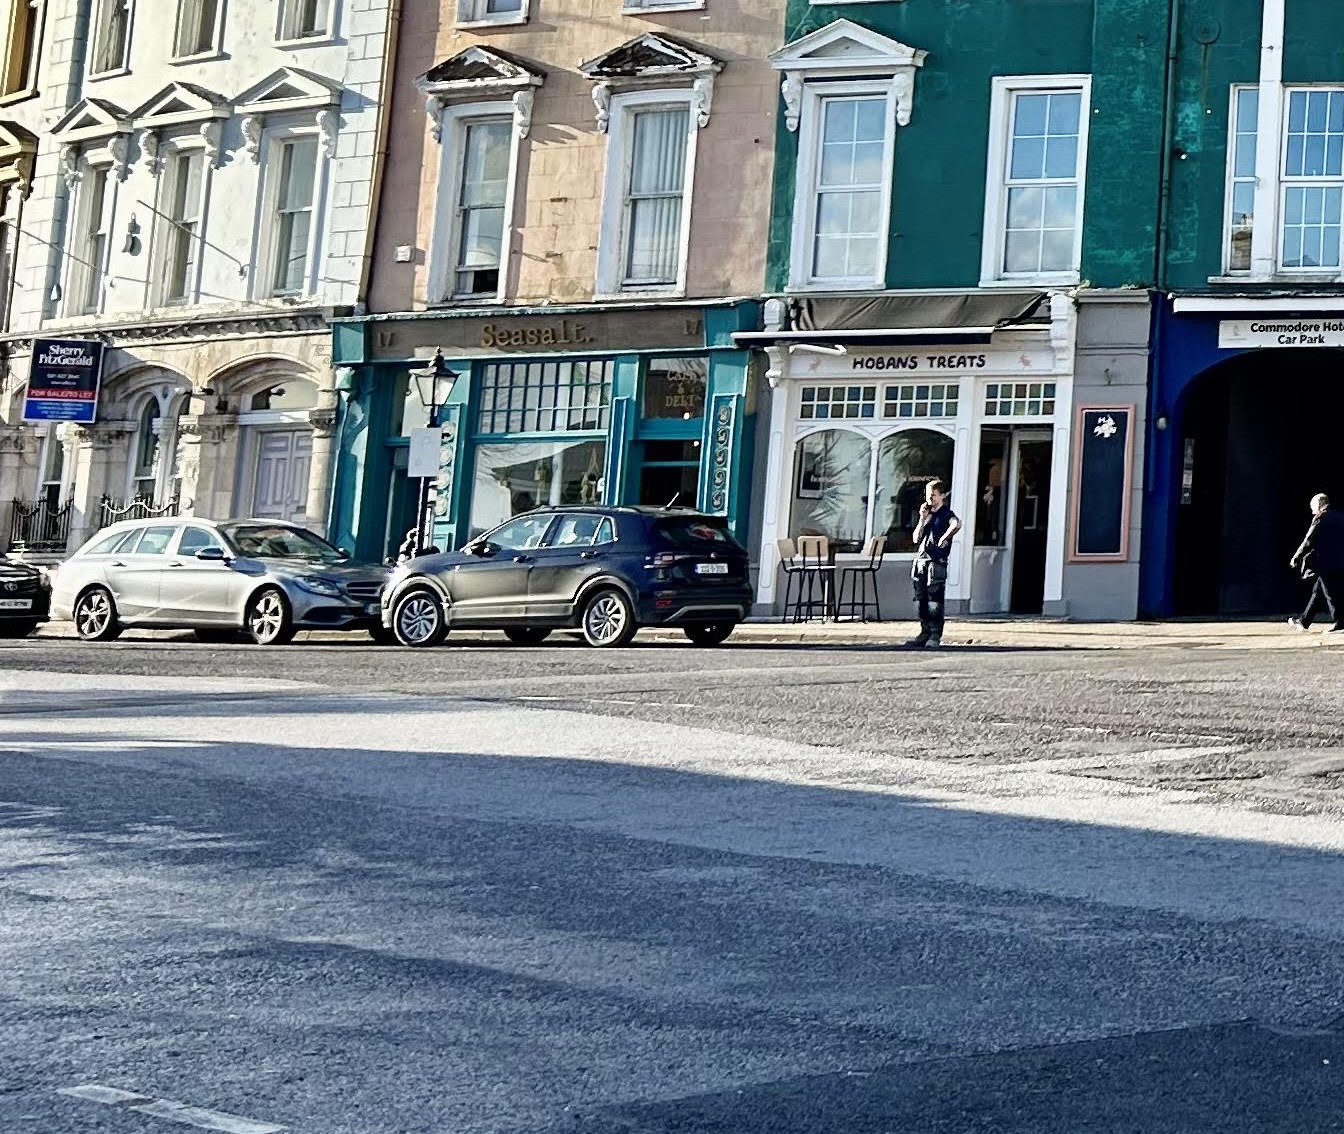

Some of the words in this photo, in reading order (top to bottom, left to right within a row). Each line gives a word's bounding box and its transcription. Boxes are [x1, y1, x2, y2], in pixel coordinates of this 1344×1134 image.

[1250, 322, 1321, 333] Commodore
[1278, 335, 1297, 345] Car
[1299, 334, 1325, 344] Park
[49, 345, 84, 356] Sherry
[926, 354, 987, 369] TREATS
